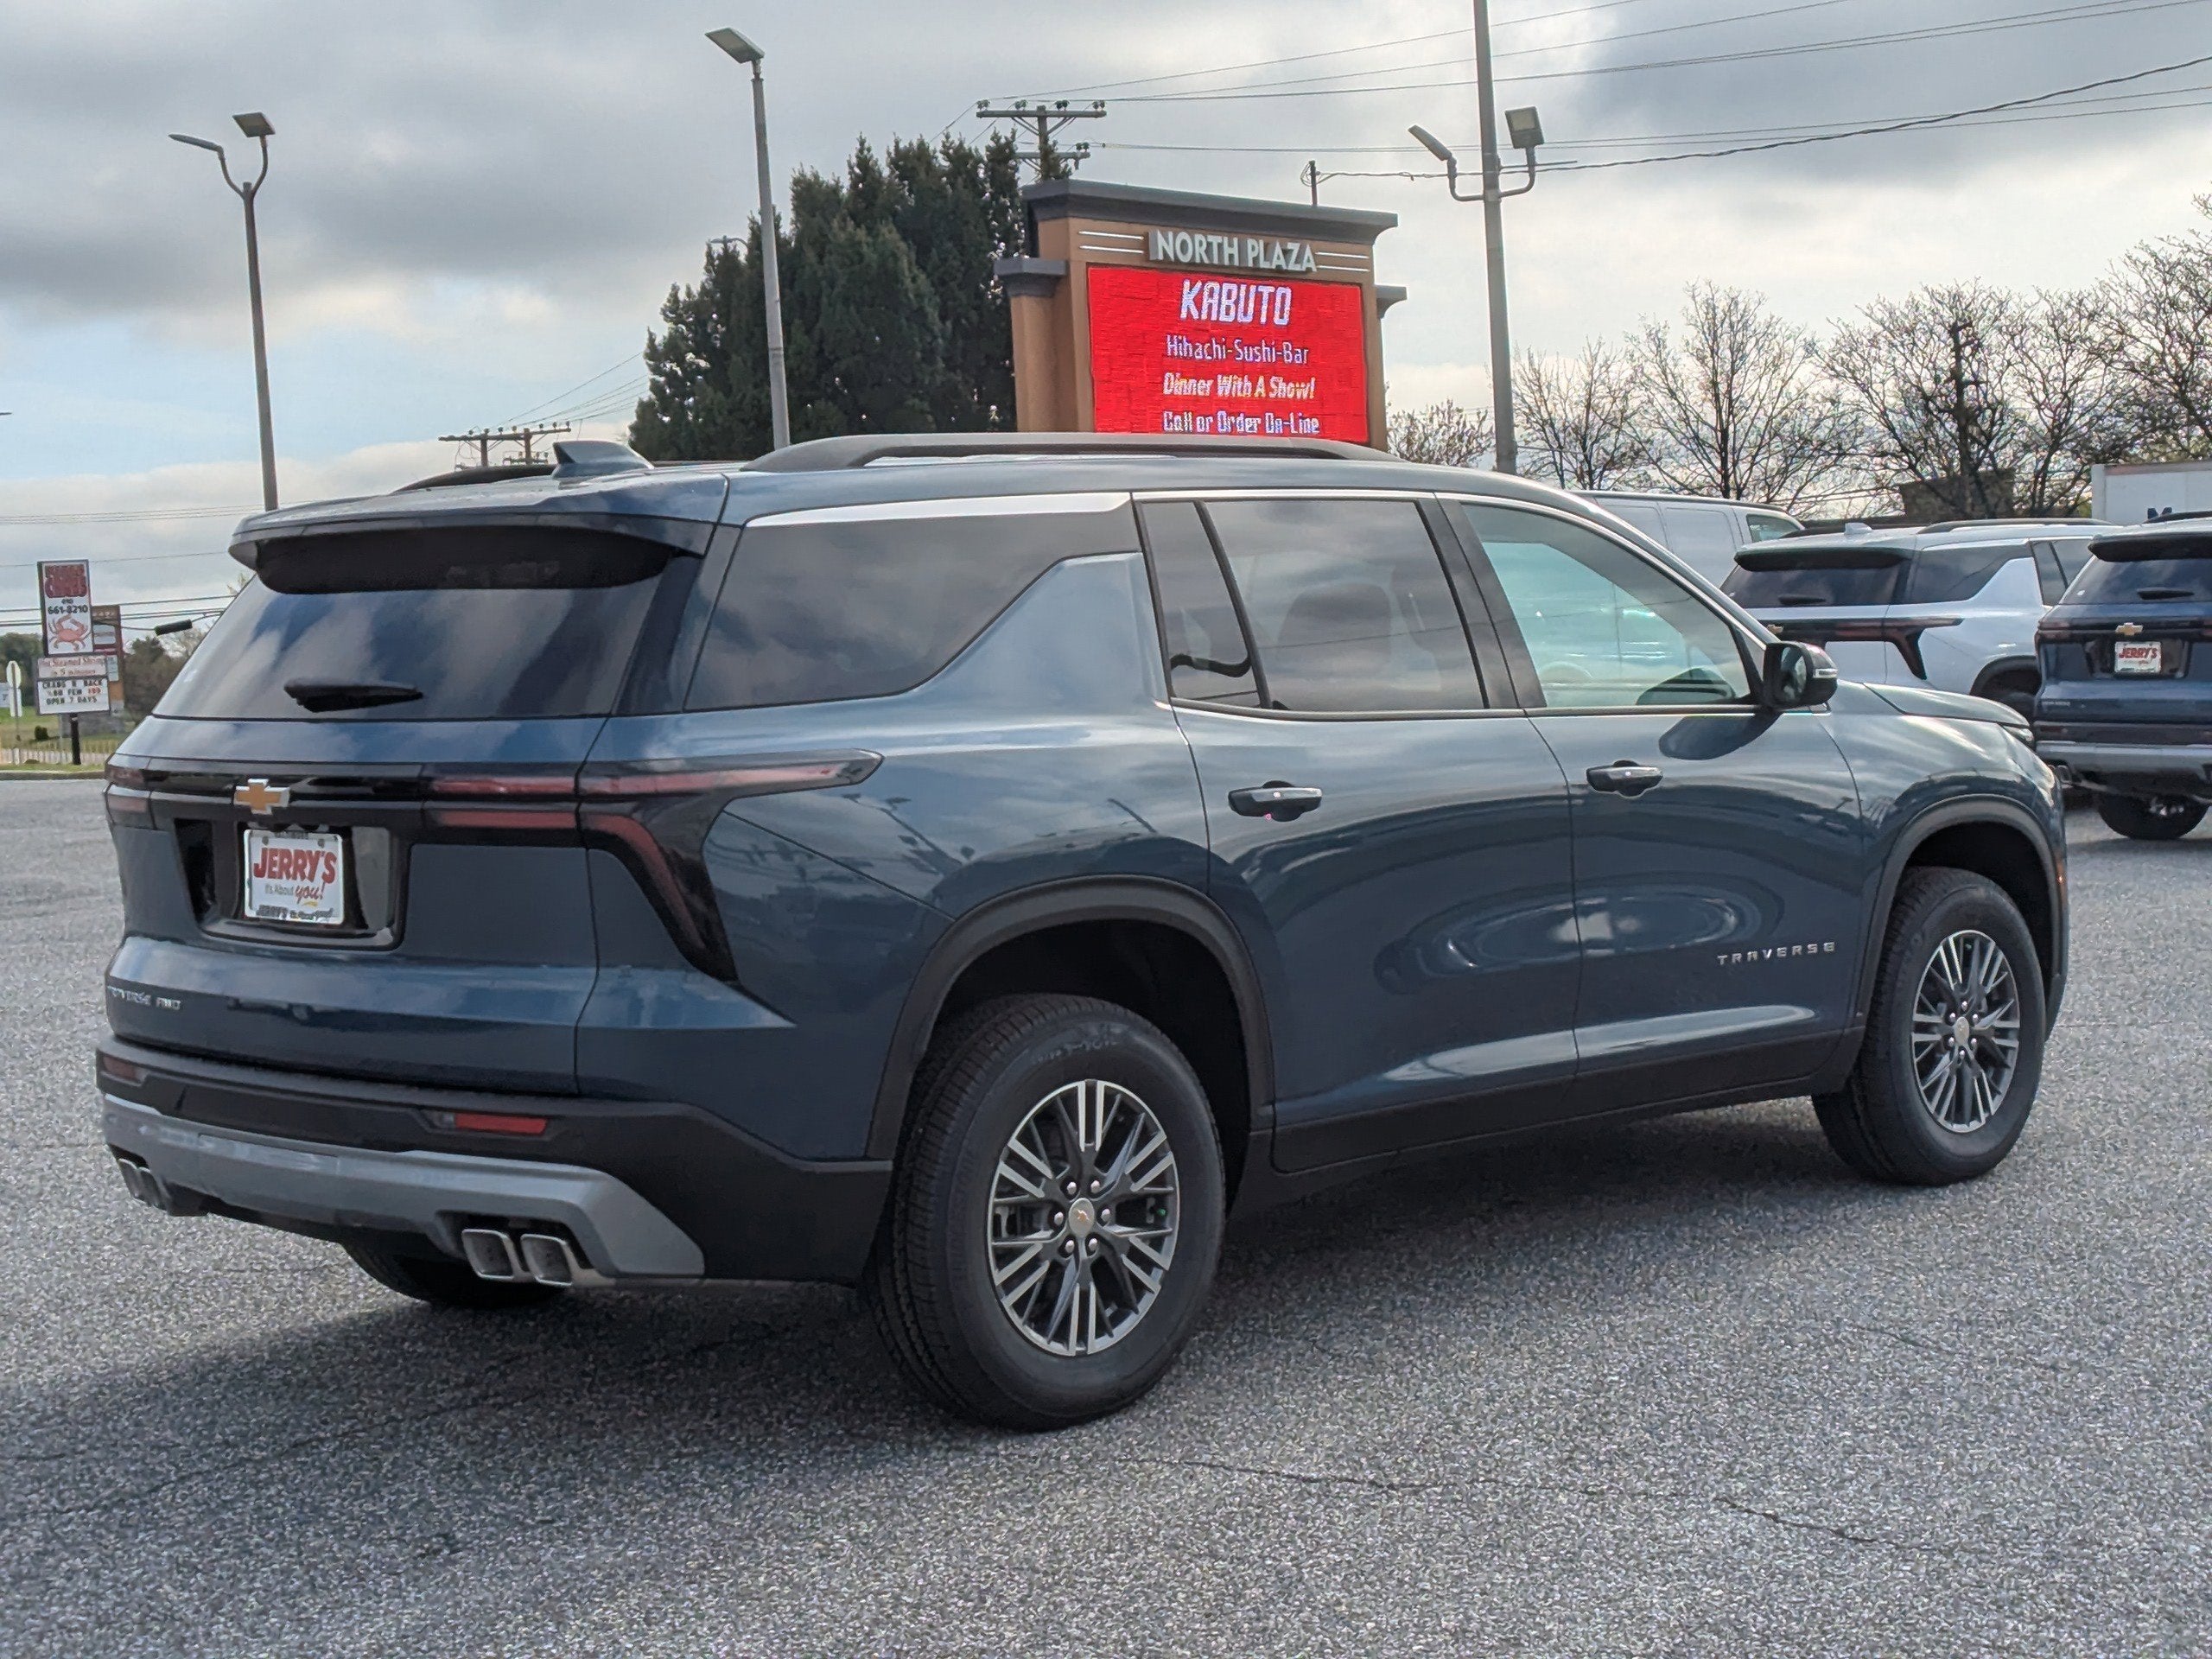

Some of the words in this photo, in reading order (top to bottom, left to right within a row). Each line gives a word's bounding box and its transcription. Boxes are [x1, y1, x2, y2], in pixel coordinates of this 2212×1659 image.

[1155, 229, 1240, 266] NORTH
[1246, 238, 1318, 272] PLAZA
[1179, 278, 1293, 327] KABUTO
[1162, 372, 1214, 397] Dinner
[1217, 373, 1253, 398] With
[1254, 375, 1266, 398] A
[1268, 375, 1316, 399] Show!
[1163, 410, 1193, 432] Call
[1196, 415, 1214, 433] or
[1217, 410, 1262, 434] Order
[253, 847, 337, 885] JERRY'S
[1717, 941, 1835, 965] TRAVERSE
